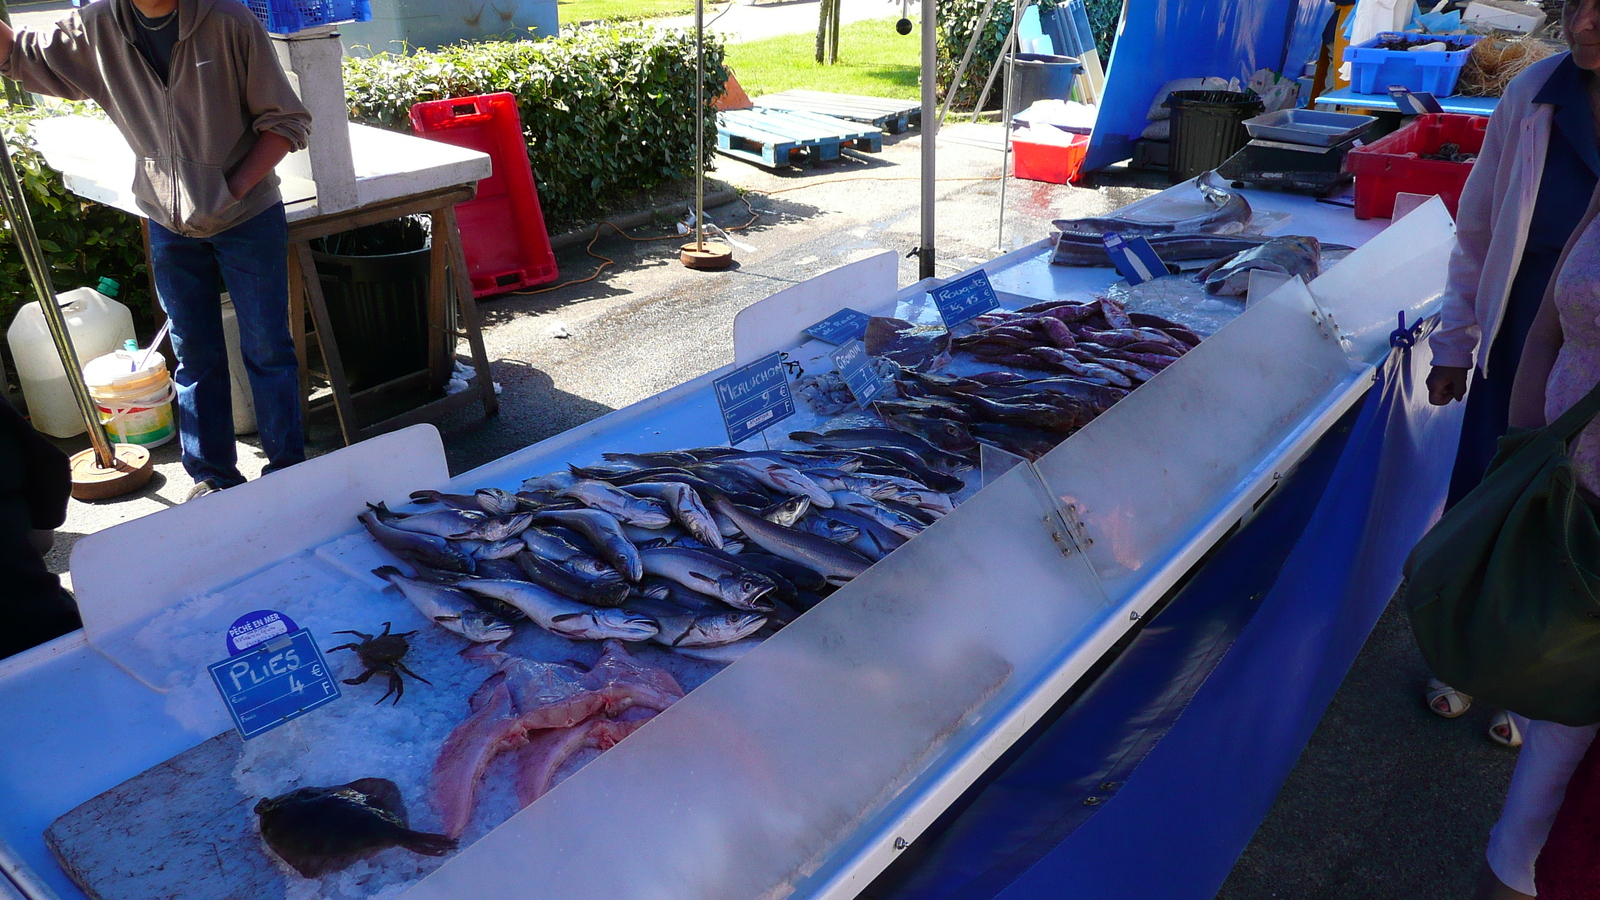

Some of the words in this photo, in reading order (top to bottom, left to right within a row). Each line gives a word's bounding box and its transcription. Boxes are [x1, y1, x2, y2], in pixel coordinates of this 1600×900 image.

[761, 391, 770, 408] 9
[779, 385, 788, 397] €
[784, 400, 790, 412] F
[229, 621, 253, 637] PÊCHÉ
[253, 618, 263, 628] EN
[264, 613, 281, 624] MER
[288, 674, 304, 694] 4
[311, 664, 324, 677] €
[321, 681, 330, 695] F
